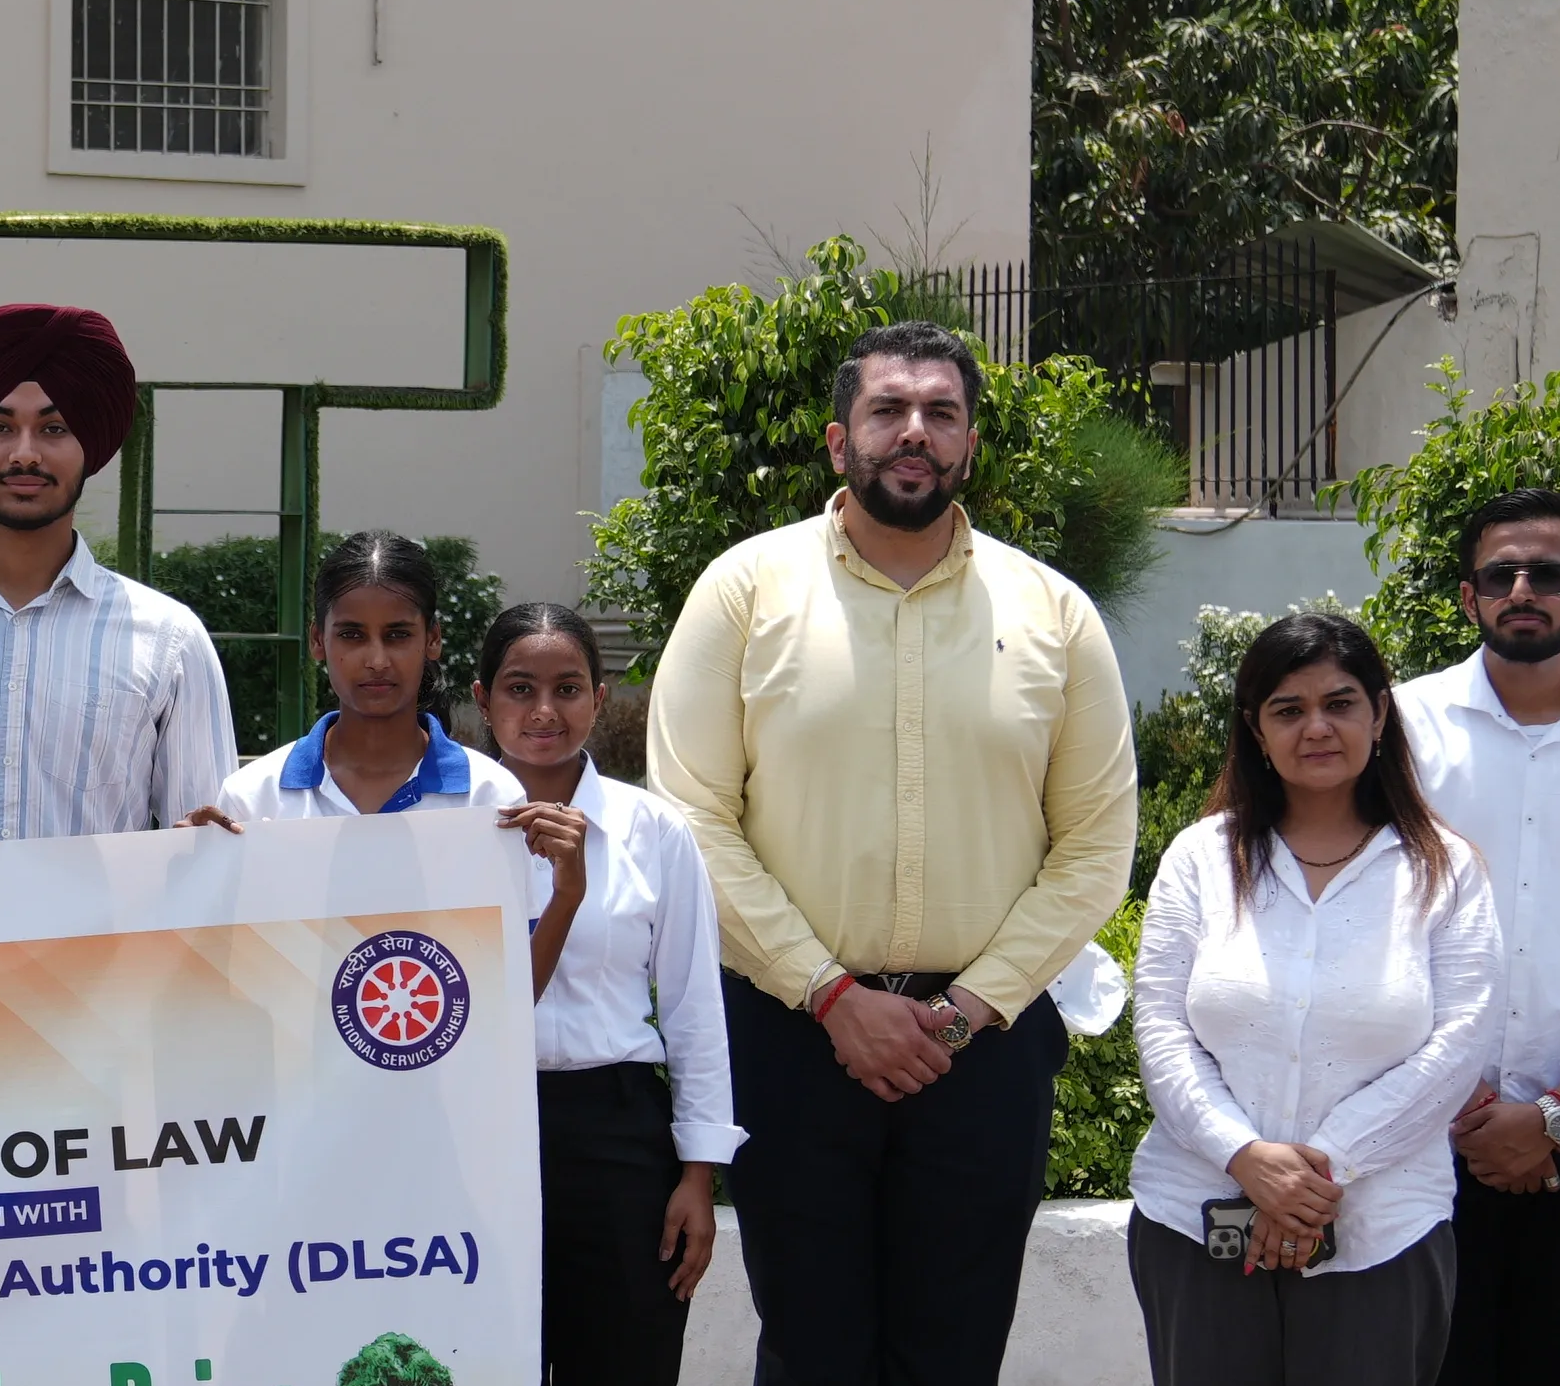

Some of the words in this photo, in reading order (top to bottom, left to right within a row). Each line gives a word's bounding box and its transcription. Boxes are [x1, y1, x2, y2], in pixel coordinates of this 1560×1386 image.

[339, 945, 376, 989] राष्ट्रीय
[379, 933, 414, 951] सेवा
[419, 940, 460, 984] योजना
[336, 1005, 376, 1062] NATIONAL
[381, 1045, 437, 1066] SERVICE
[435, 997, 465, 1050] SCHEME
[0, 1128, 88, 1179] OF
[111, 1115, 266, 1172] LAW
[13, 1200, 88, 1225] WITH
[288, 1231, 480, 1294] (DLSA)
